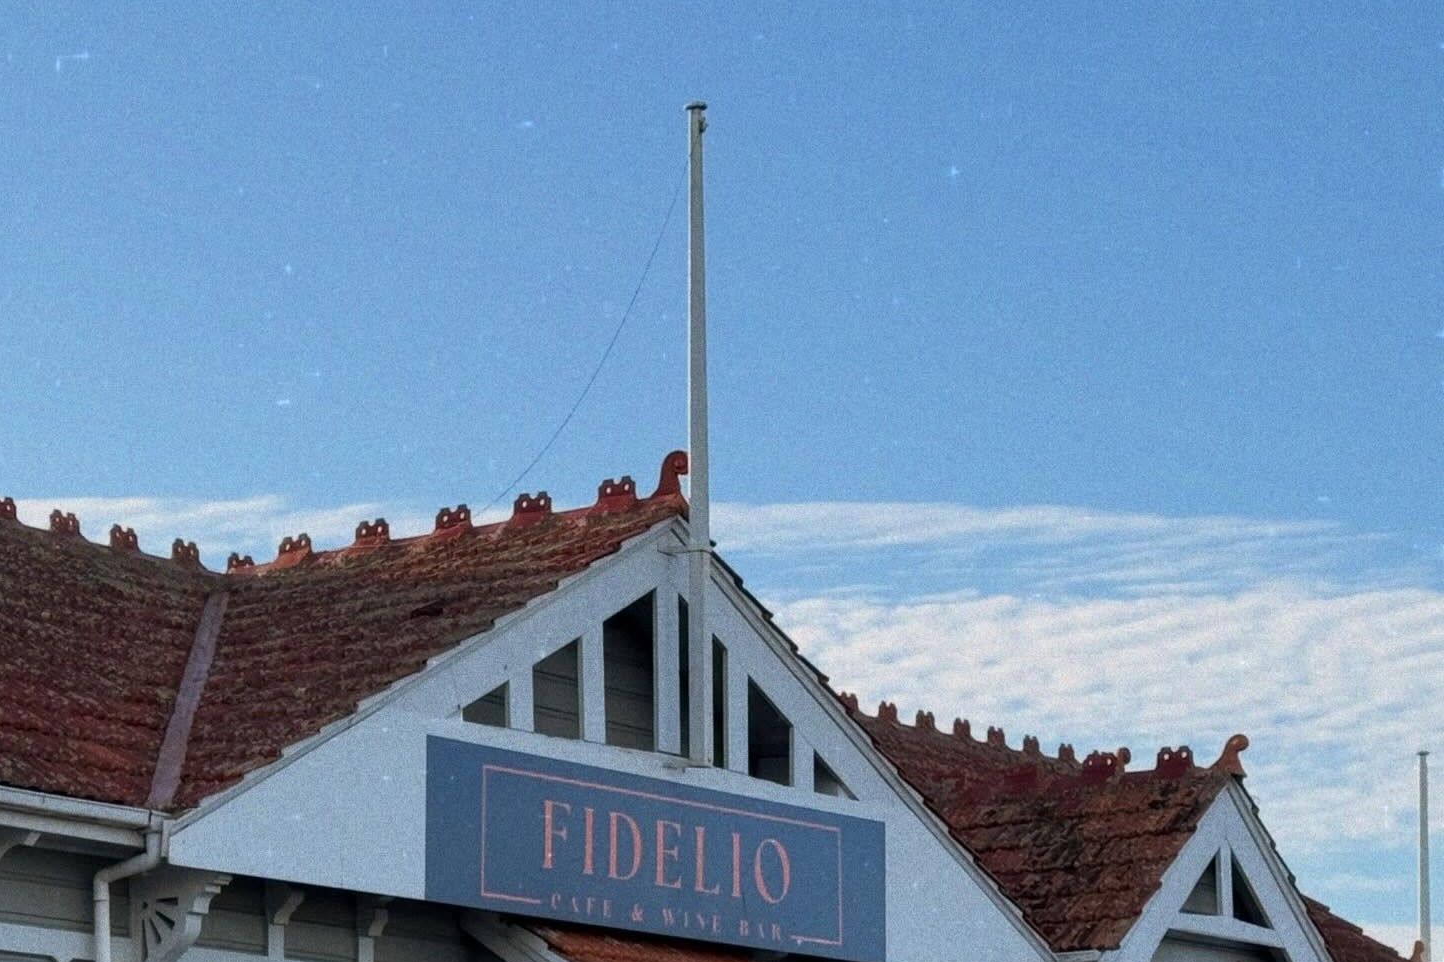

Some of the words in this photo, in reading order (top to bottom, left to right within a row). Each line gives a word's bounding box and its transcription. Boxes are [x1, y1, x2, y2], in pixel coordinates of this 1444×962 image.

[542, 799, 791, 905] FIDELIO
[551, 893, 613, 918] CAFE
[631, 902, 645, 922] &
[662, 907, 721, 934] WINE
[739, 918, 782, 942] BAR
